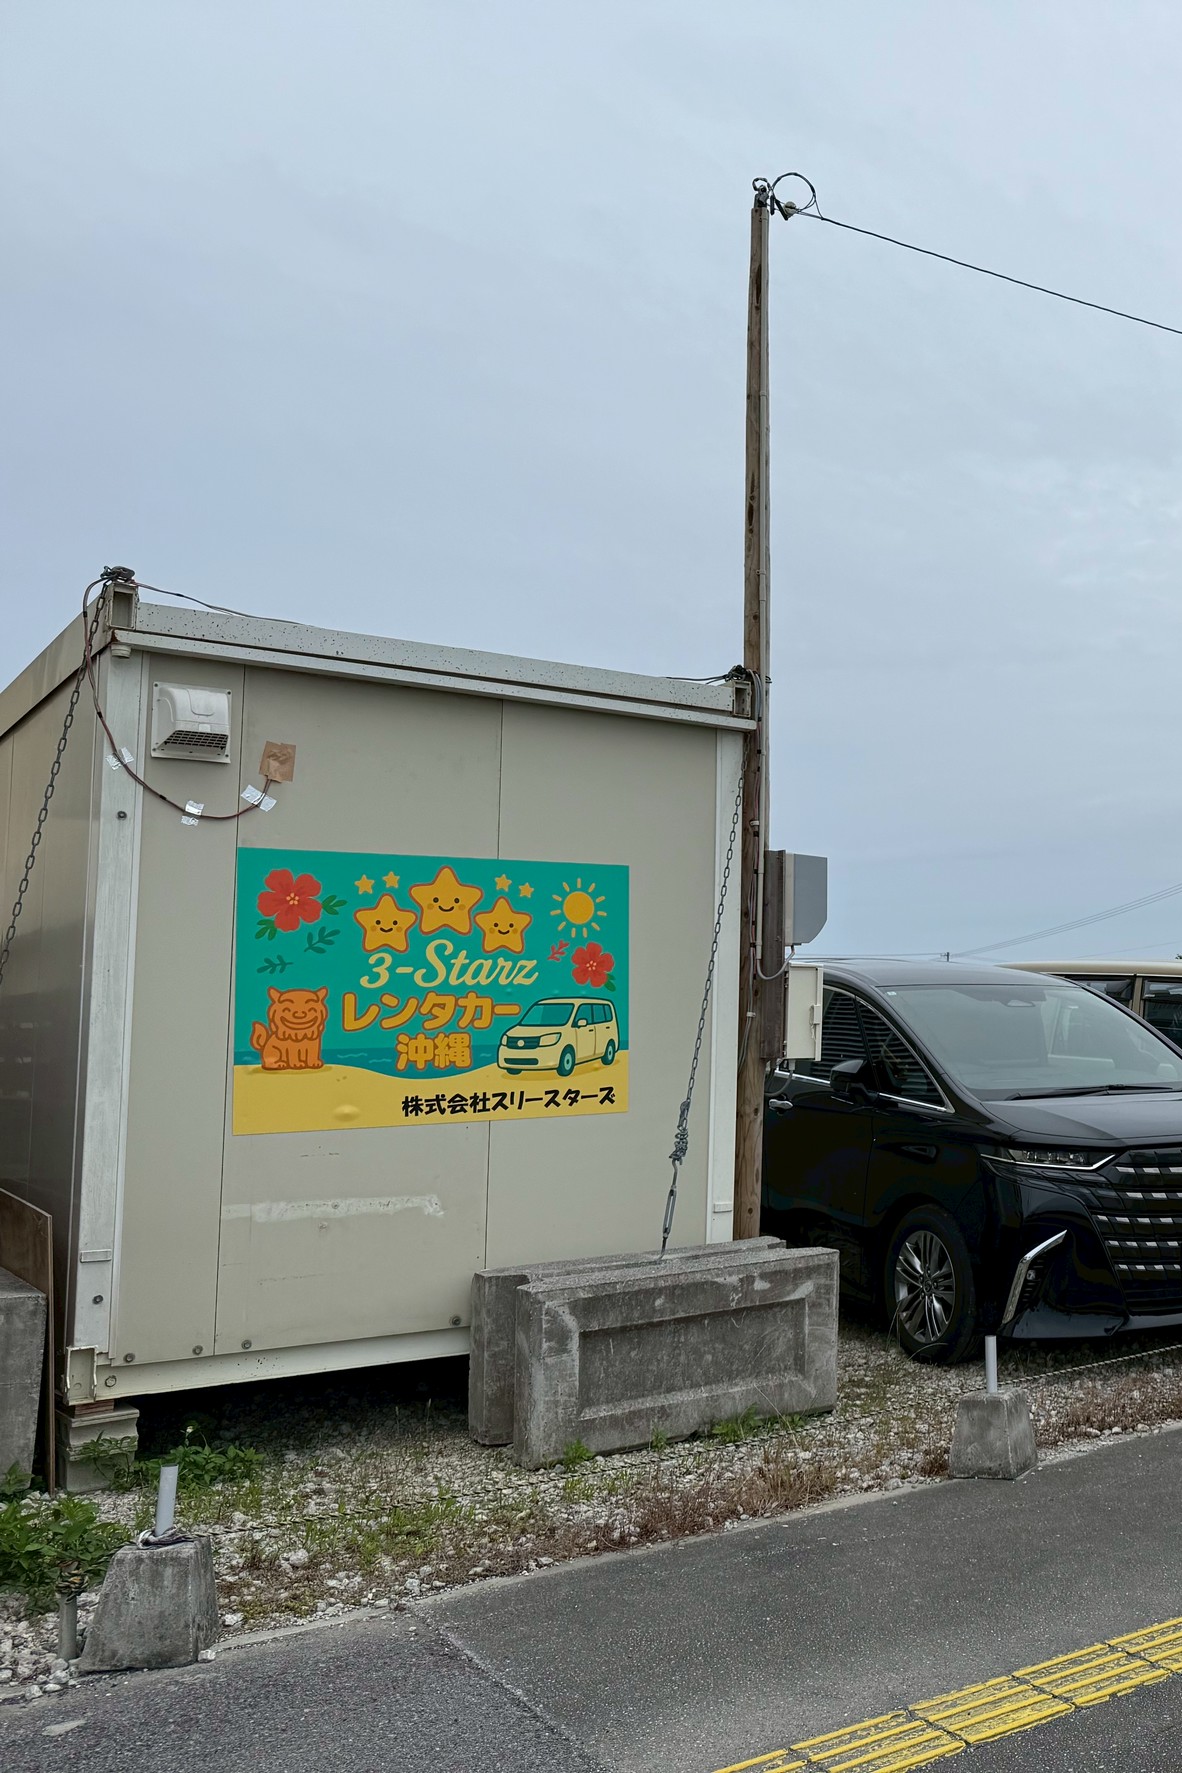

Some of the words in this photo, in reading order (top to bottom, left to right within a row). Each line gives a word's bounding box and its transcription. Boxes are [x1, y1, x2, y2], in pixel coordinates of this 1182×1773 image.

[359, 939, 540, 988] 3-Starz
[341, 991, 522, 1033] レンタカー
[395, 1032, 473, 1072] 沖縄
[401, 1086, 616, 1117] 株式会社スリースターズ
